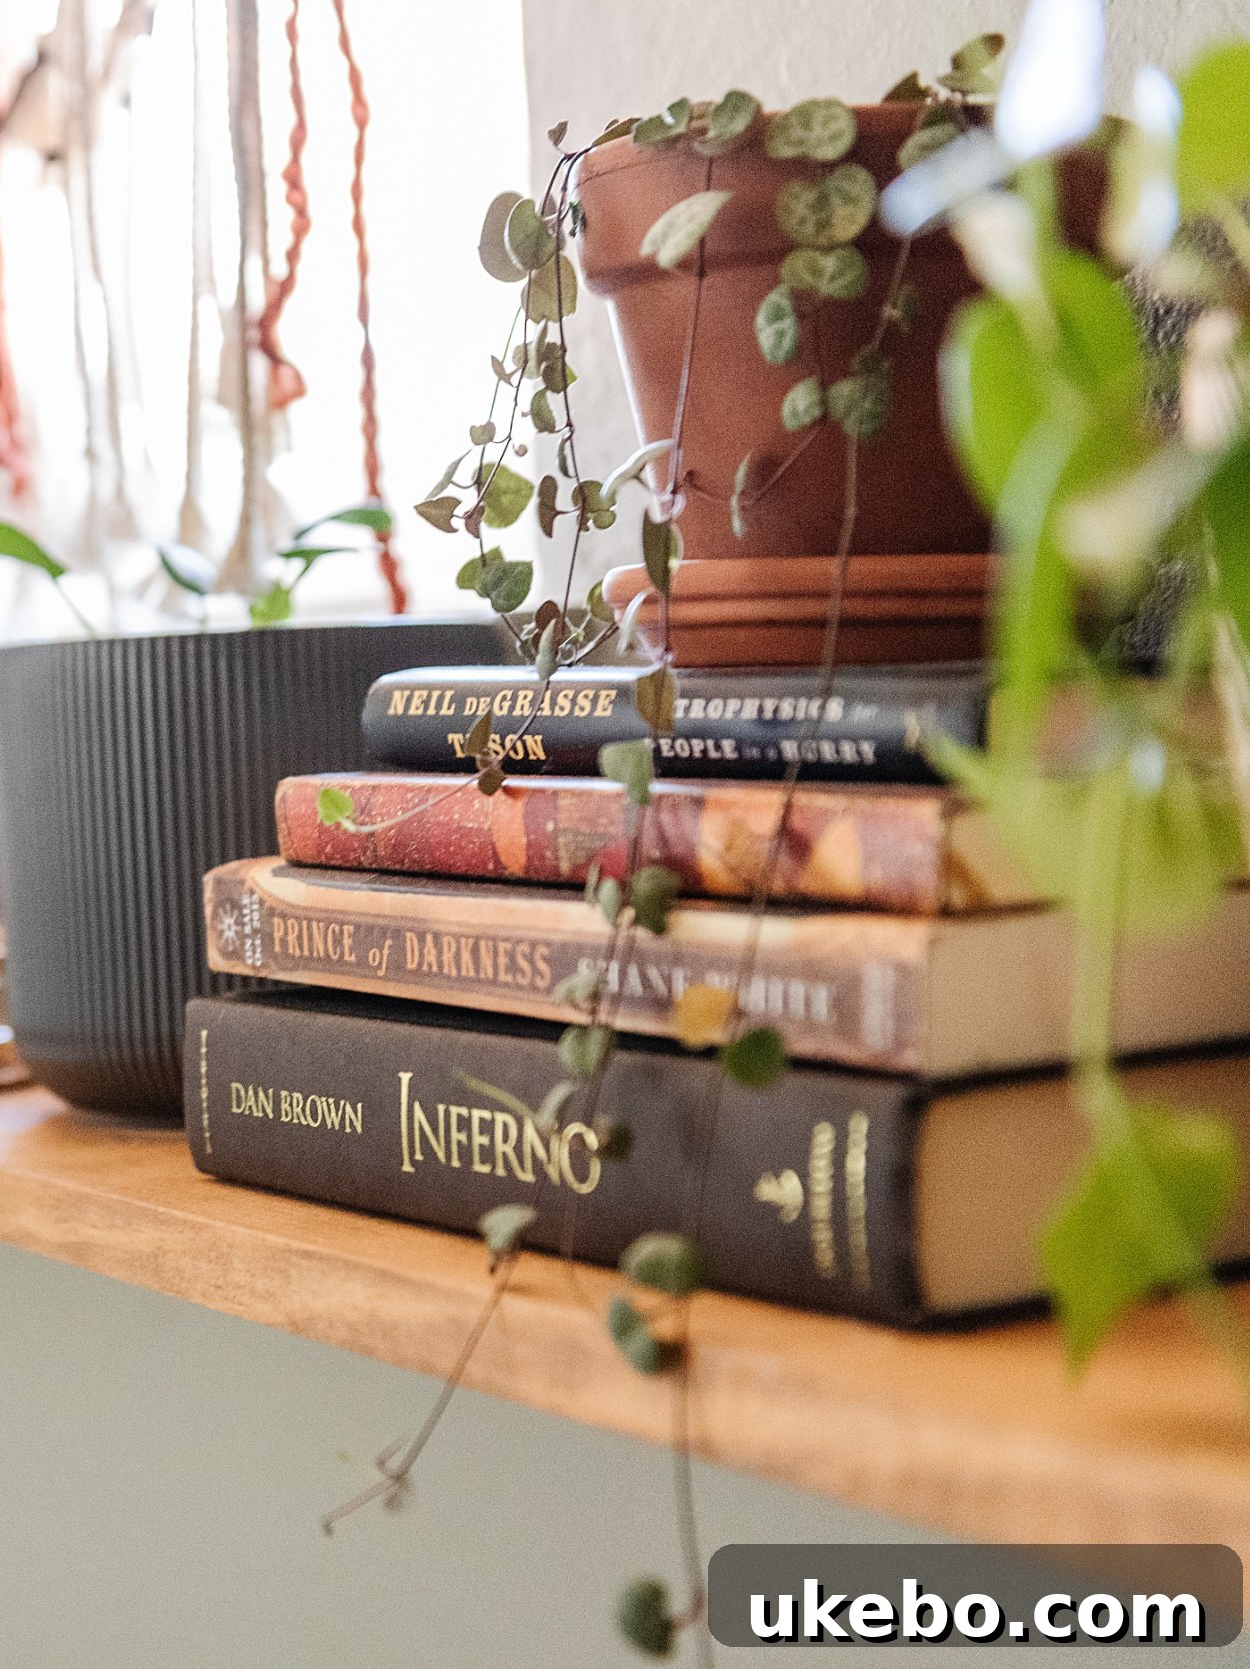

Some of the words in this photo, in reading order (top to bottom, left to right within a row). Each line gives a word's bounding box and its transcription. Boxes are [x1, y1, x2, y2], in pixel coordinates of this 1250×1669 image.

[388, 689, 456, 717] NEIL
[673, 697, 845, 723] TROPHYSICS
[447, 732, 547, 761] TSON
[272, 915, 357, 964] PRINCE
[368, 938, 394, 978] of
[404, 930, 552, 989] DARKNESS
[230, 1081, 274, 1120] DAN
[279, 1089, 364, 1135] BROWN
[397, 1070, 602, 1195] INFERNO
